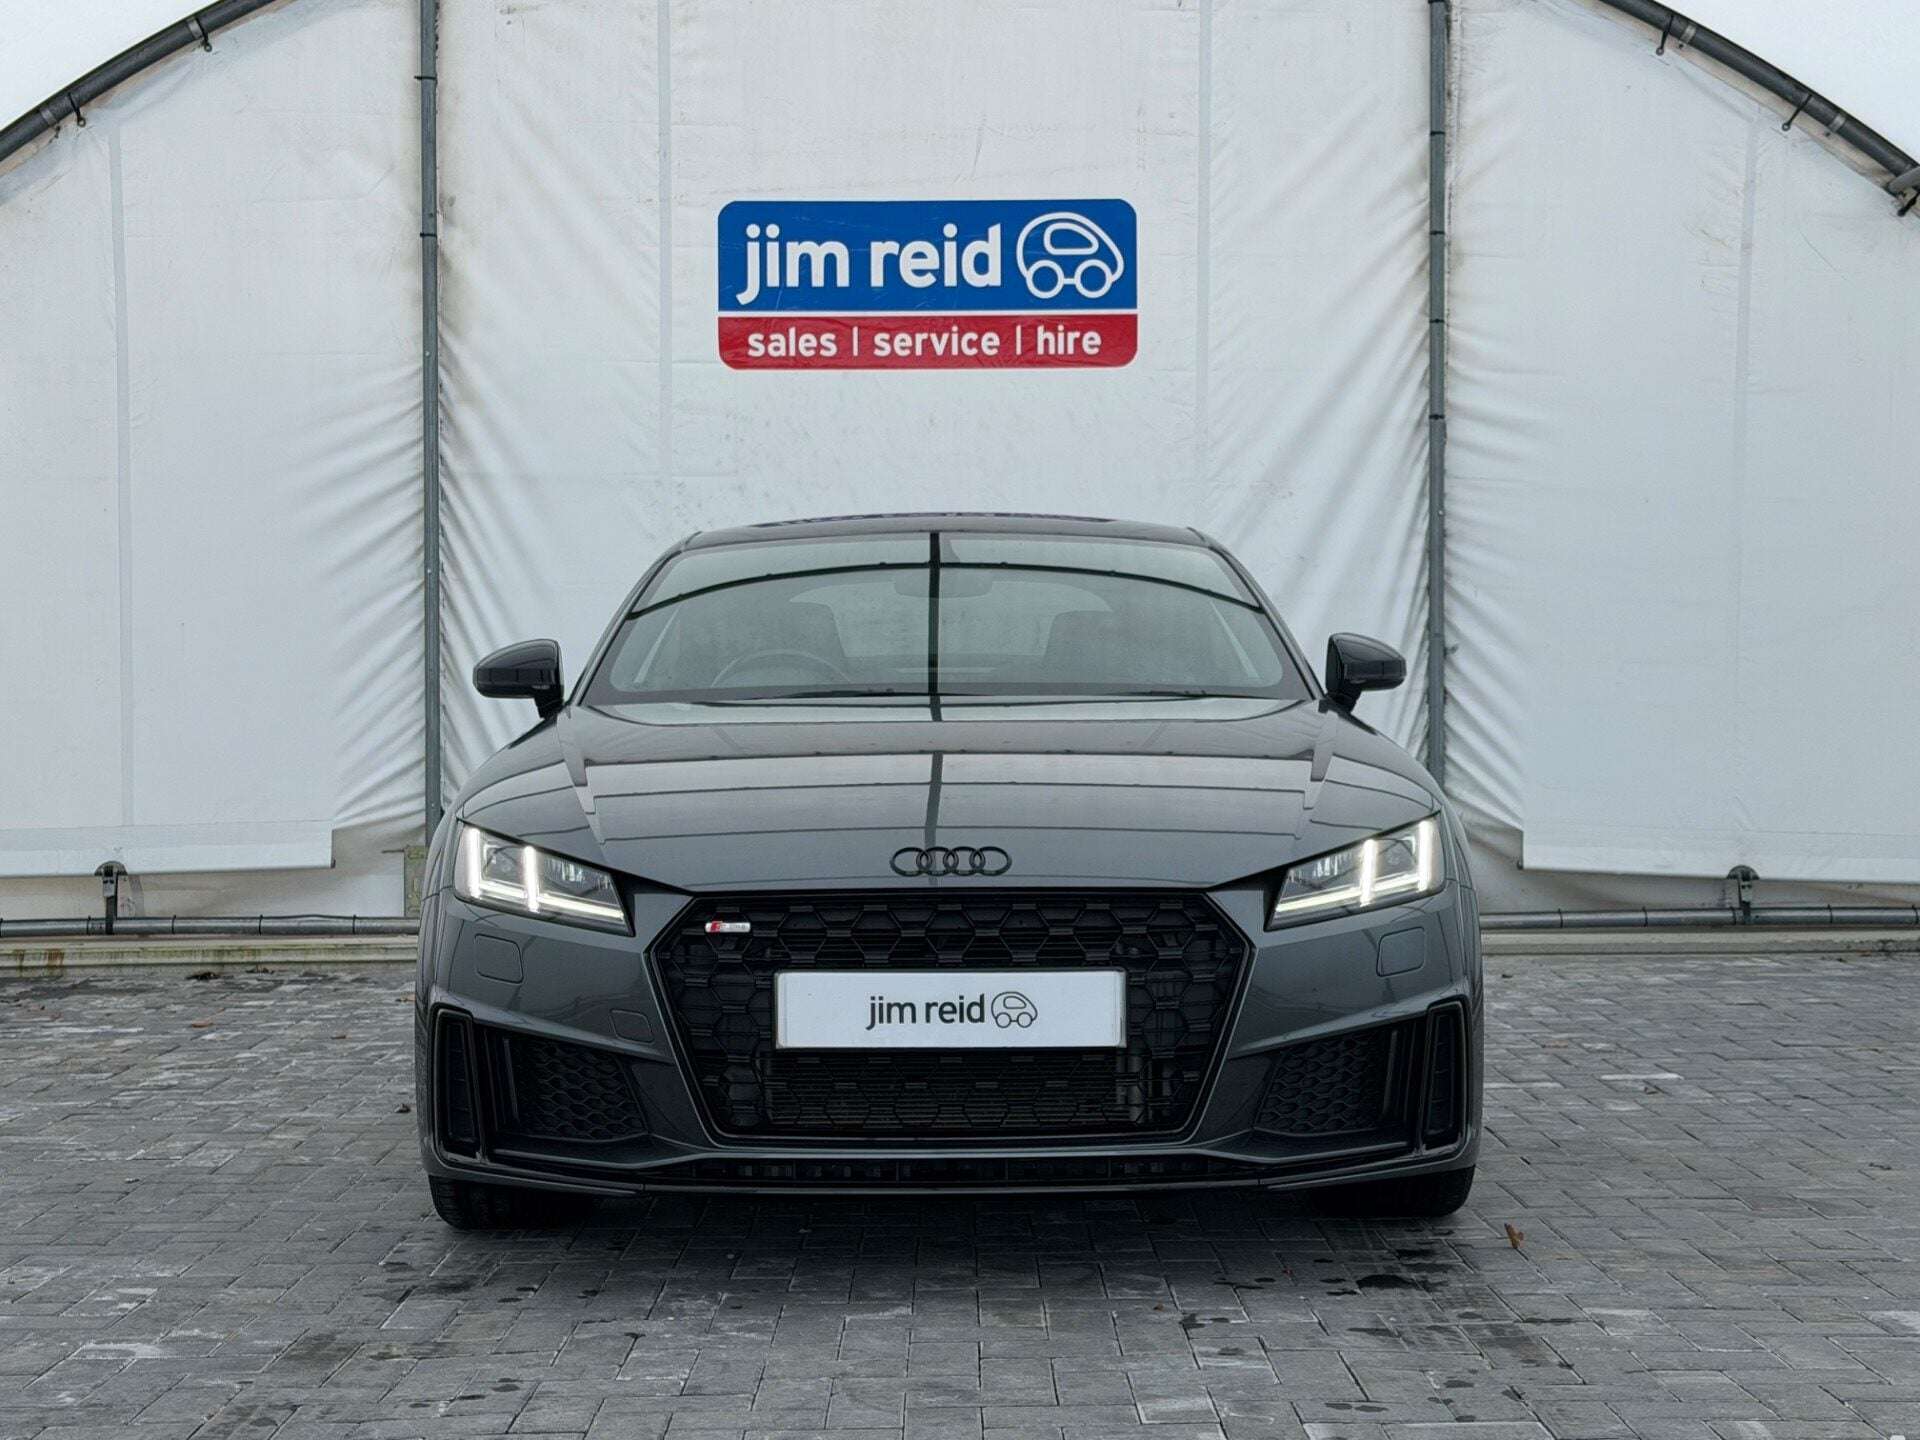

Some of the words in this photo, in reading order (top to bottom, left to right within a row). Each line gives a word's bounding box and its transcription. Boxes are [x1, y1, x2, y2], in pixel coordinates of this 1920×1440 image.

[736, 224, 849, 305] jim
[870, 223, 1001, 288] reid
[747, 327, 838, 358] sales
[873, 325, 1001, 357] service
[1036, 324, 1102, 356] hire
[866, 996, 917, 1031] jim
[925, 994, 985, 1025] reid
